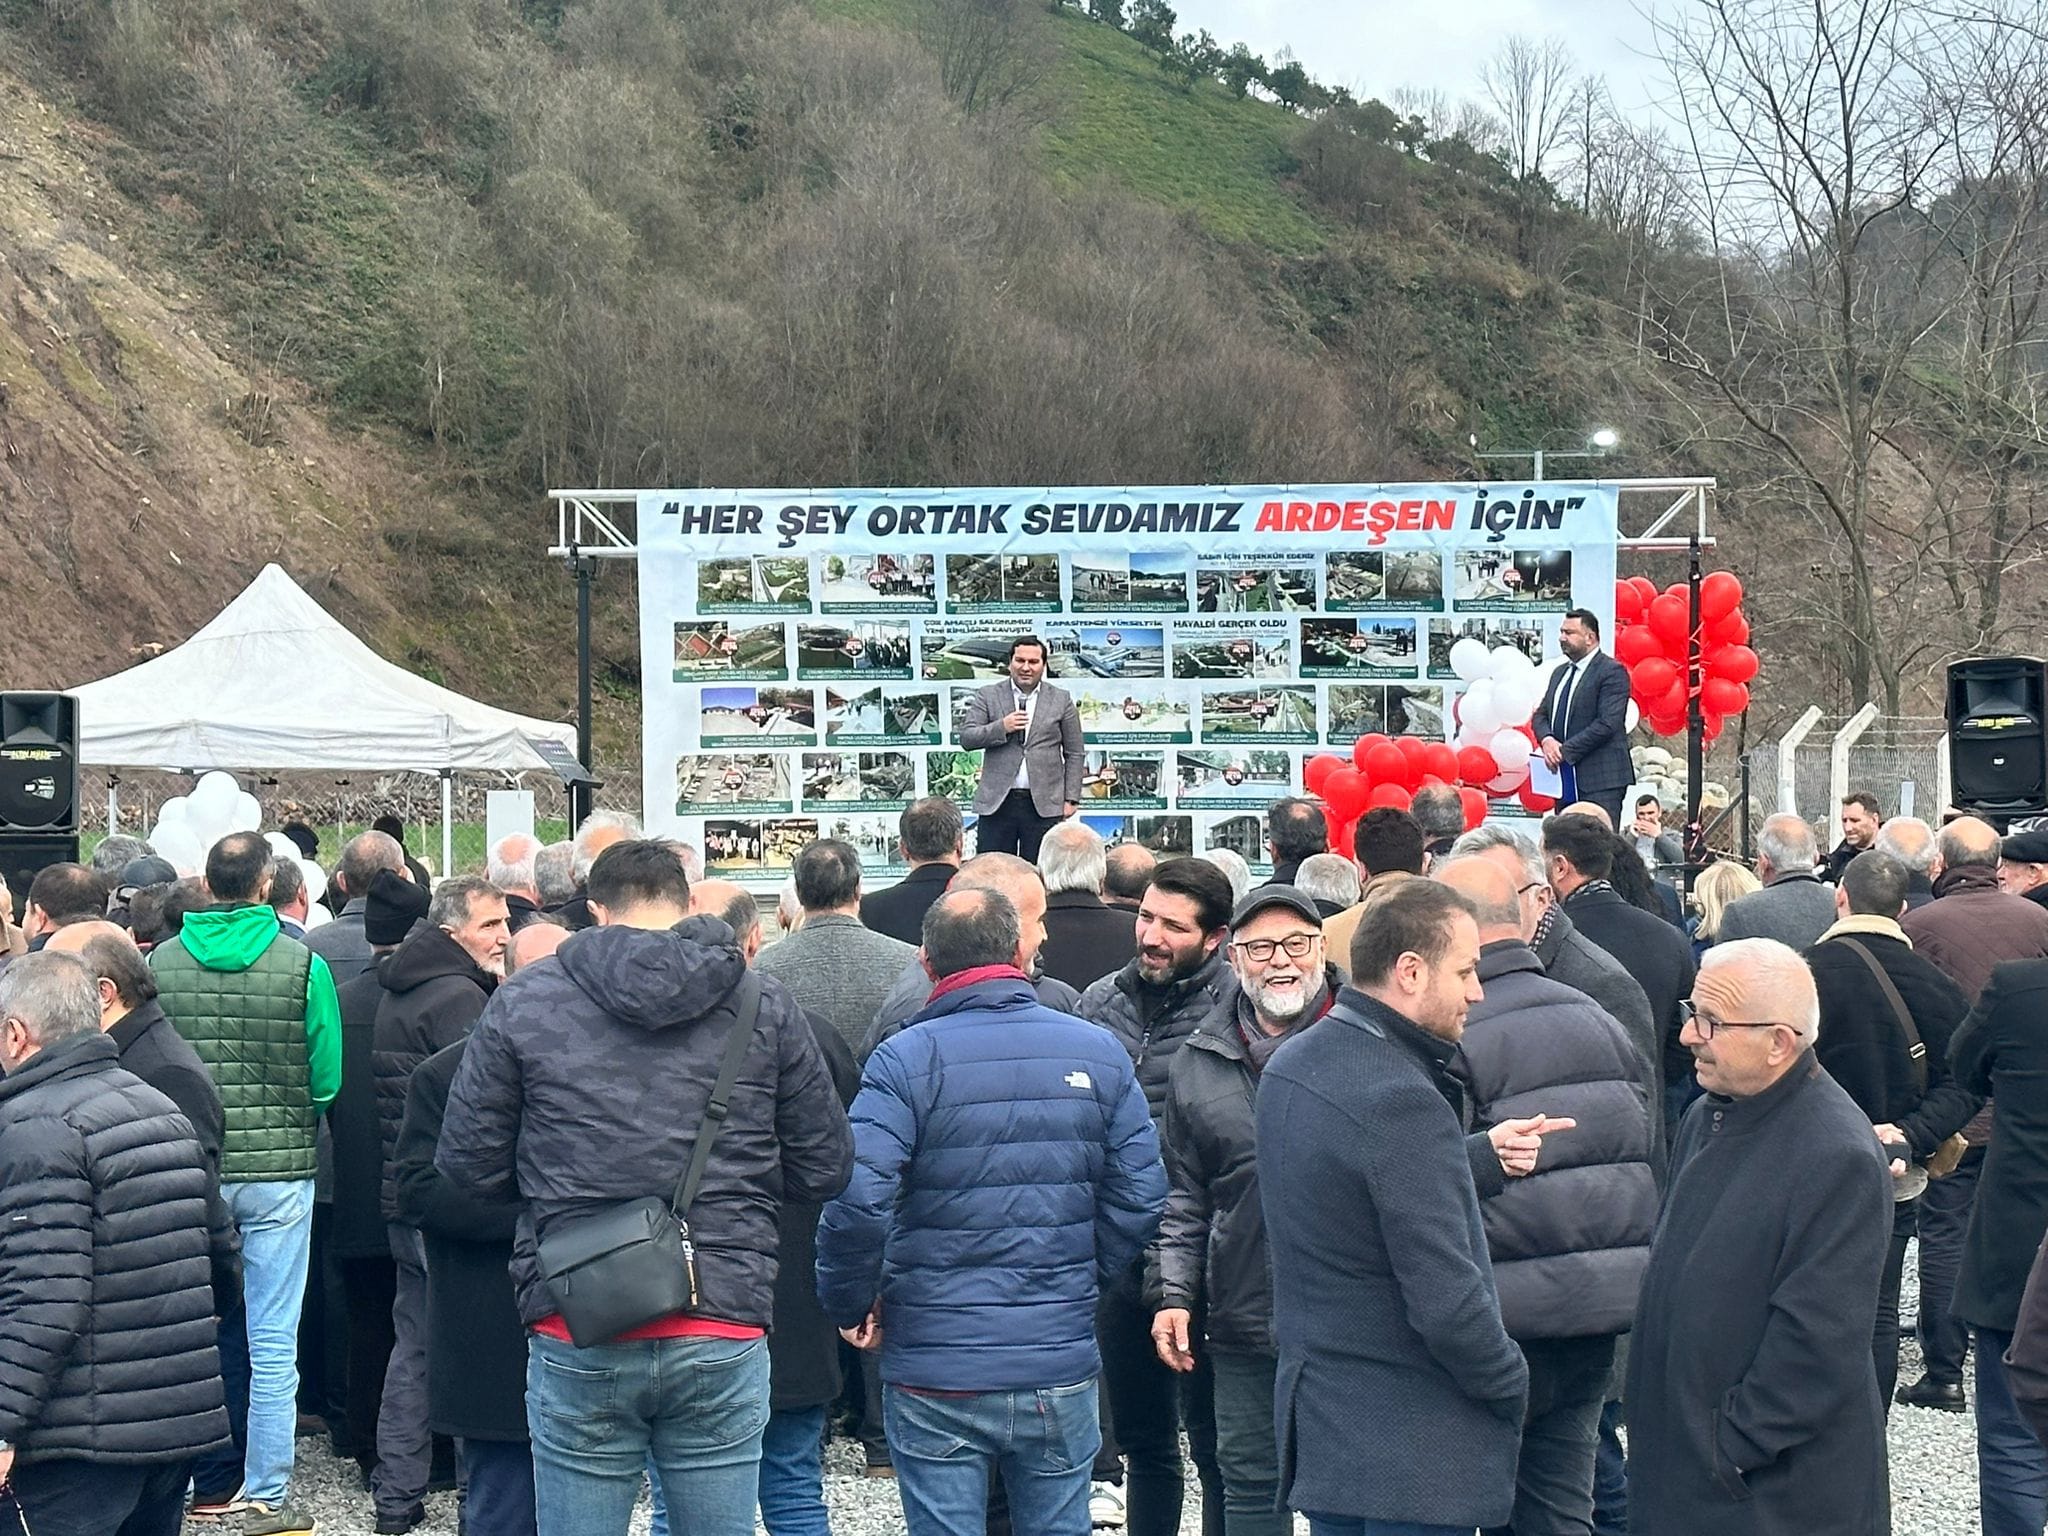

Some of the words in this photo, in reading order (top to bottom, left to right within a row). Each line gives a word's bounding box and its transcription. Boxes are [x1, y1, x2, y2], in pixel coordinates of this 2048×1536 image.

[777, 503, 863, 549] ŞEY
[867, 503, 1012, 535] ORTAK
[1021, 501, 1245, 535] SEVDAMIZ
[1254, 501, 1457, 546] ARDEŞEN
[1224, 552, 1241, 561] İÇİN
[1243, 552, 1284, 562] TEŞEKKÜR
[1173, 618, 1216, 628] HAYALDİ
[1218, 619, 1257, 629] GERÇEK
[1259, 619, 1287, 628] OLDU
